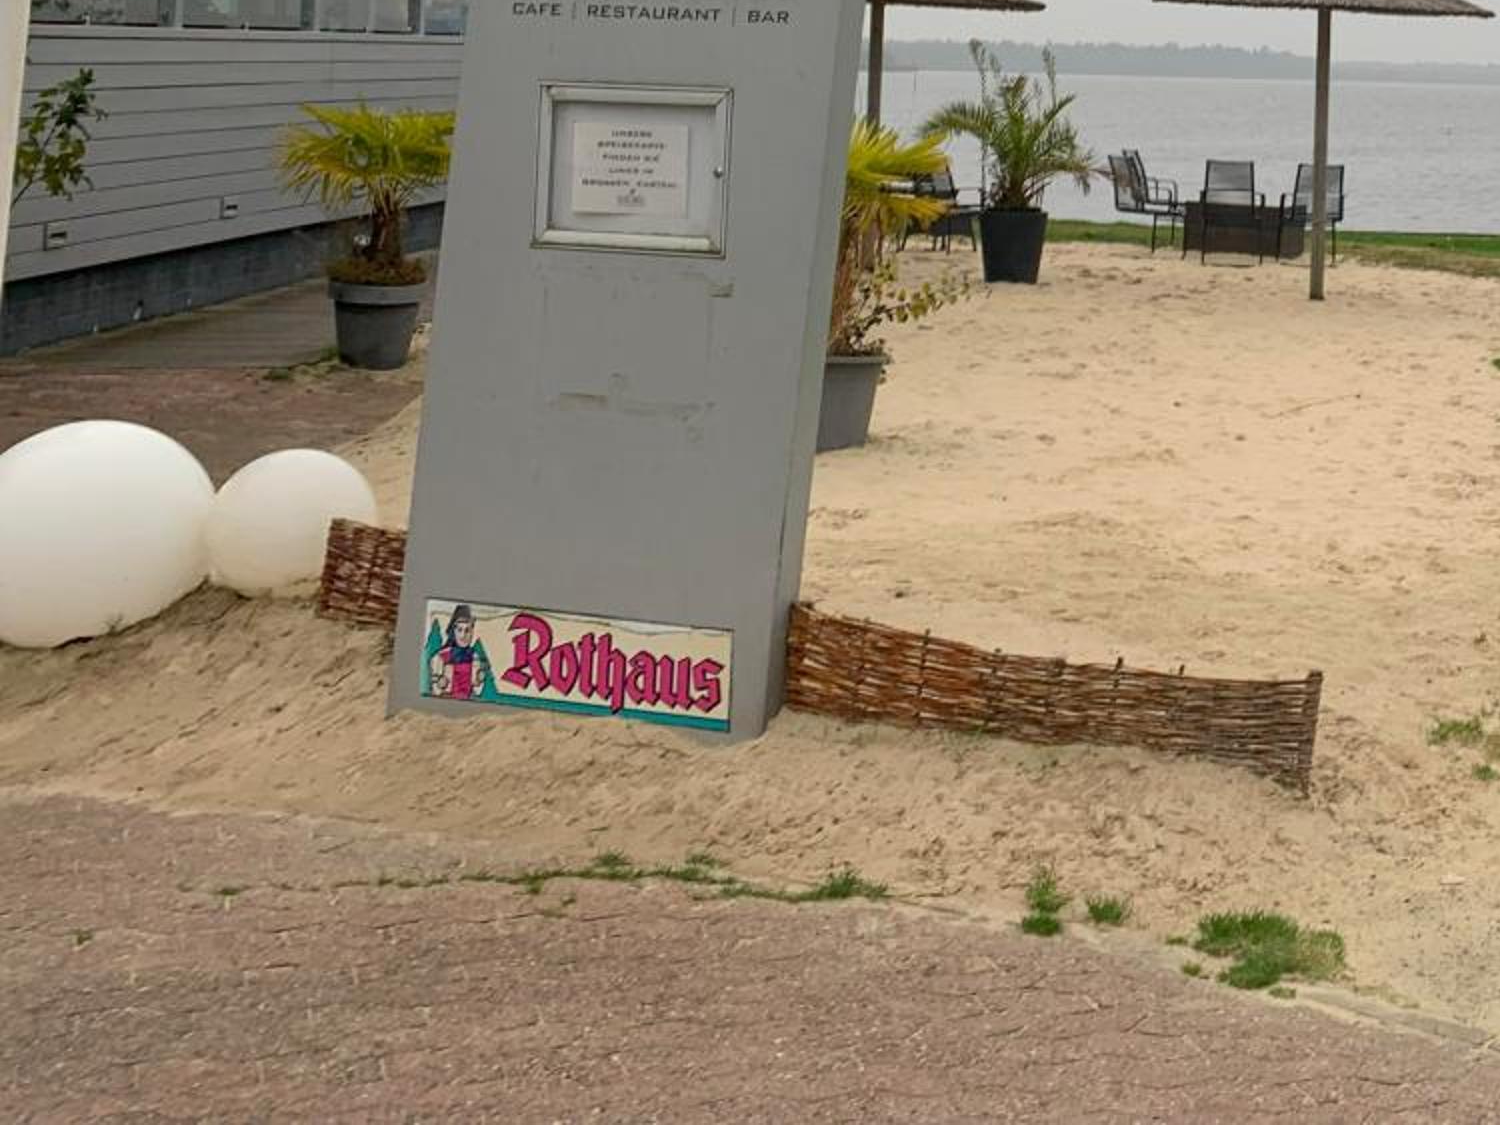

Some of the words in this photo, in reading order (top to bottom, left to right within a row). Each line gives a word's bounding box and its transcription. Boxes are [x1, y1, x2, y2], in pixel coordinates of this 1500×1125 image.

[512, 2, 561, 16] CAFE
[587, 4, 721, 22] RESTAURANT
[747, 10, 790, 24] BAR
[501, 612, 725, 714] Rothaus
